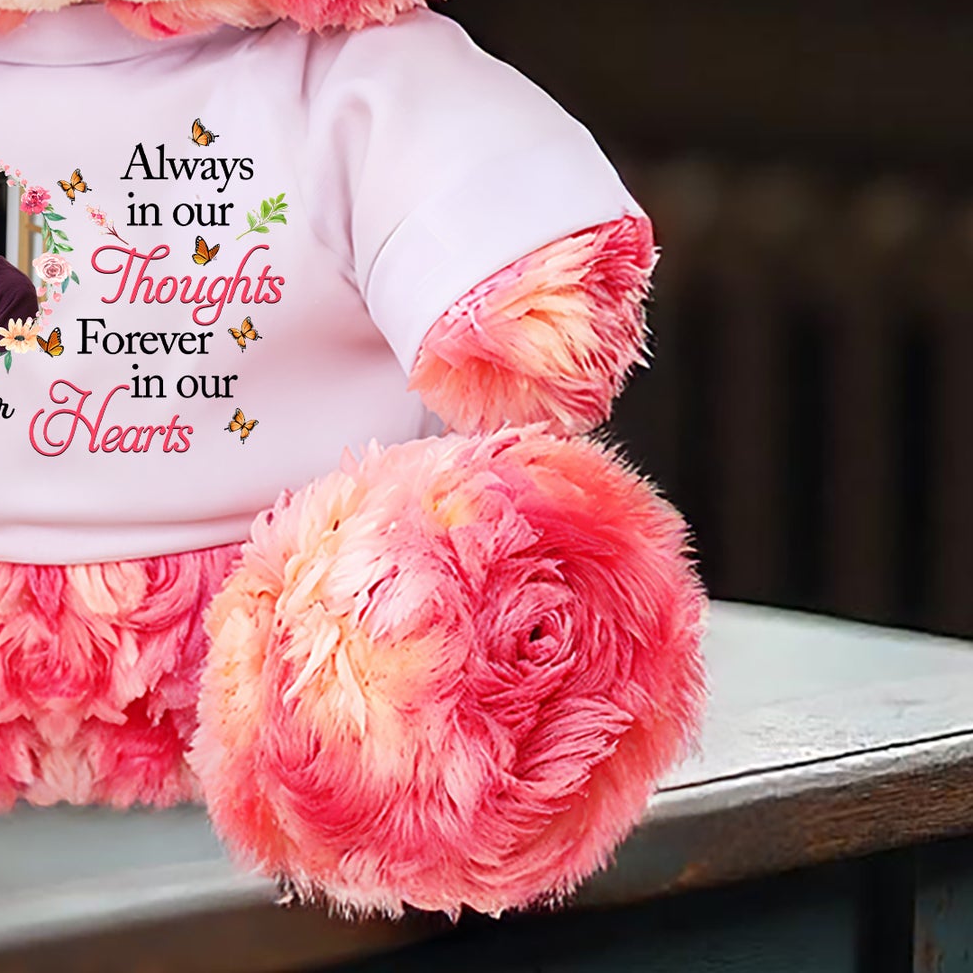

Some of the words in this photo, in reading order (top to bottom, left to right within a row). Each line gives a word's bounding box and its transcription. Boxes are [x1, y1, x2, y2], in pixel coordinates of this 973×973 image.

[120, 143, 254, 193] Always
[127, 192, 162, 226] in
[173, 203, 234, 226] our
[91, 244, 285, 326] Thoughts
[77, 319, 215, 354] Forever
[130, 364, 166, 398] in
[177, 375, 238, 398] our
[29, 379, 193, 455] Hearts
